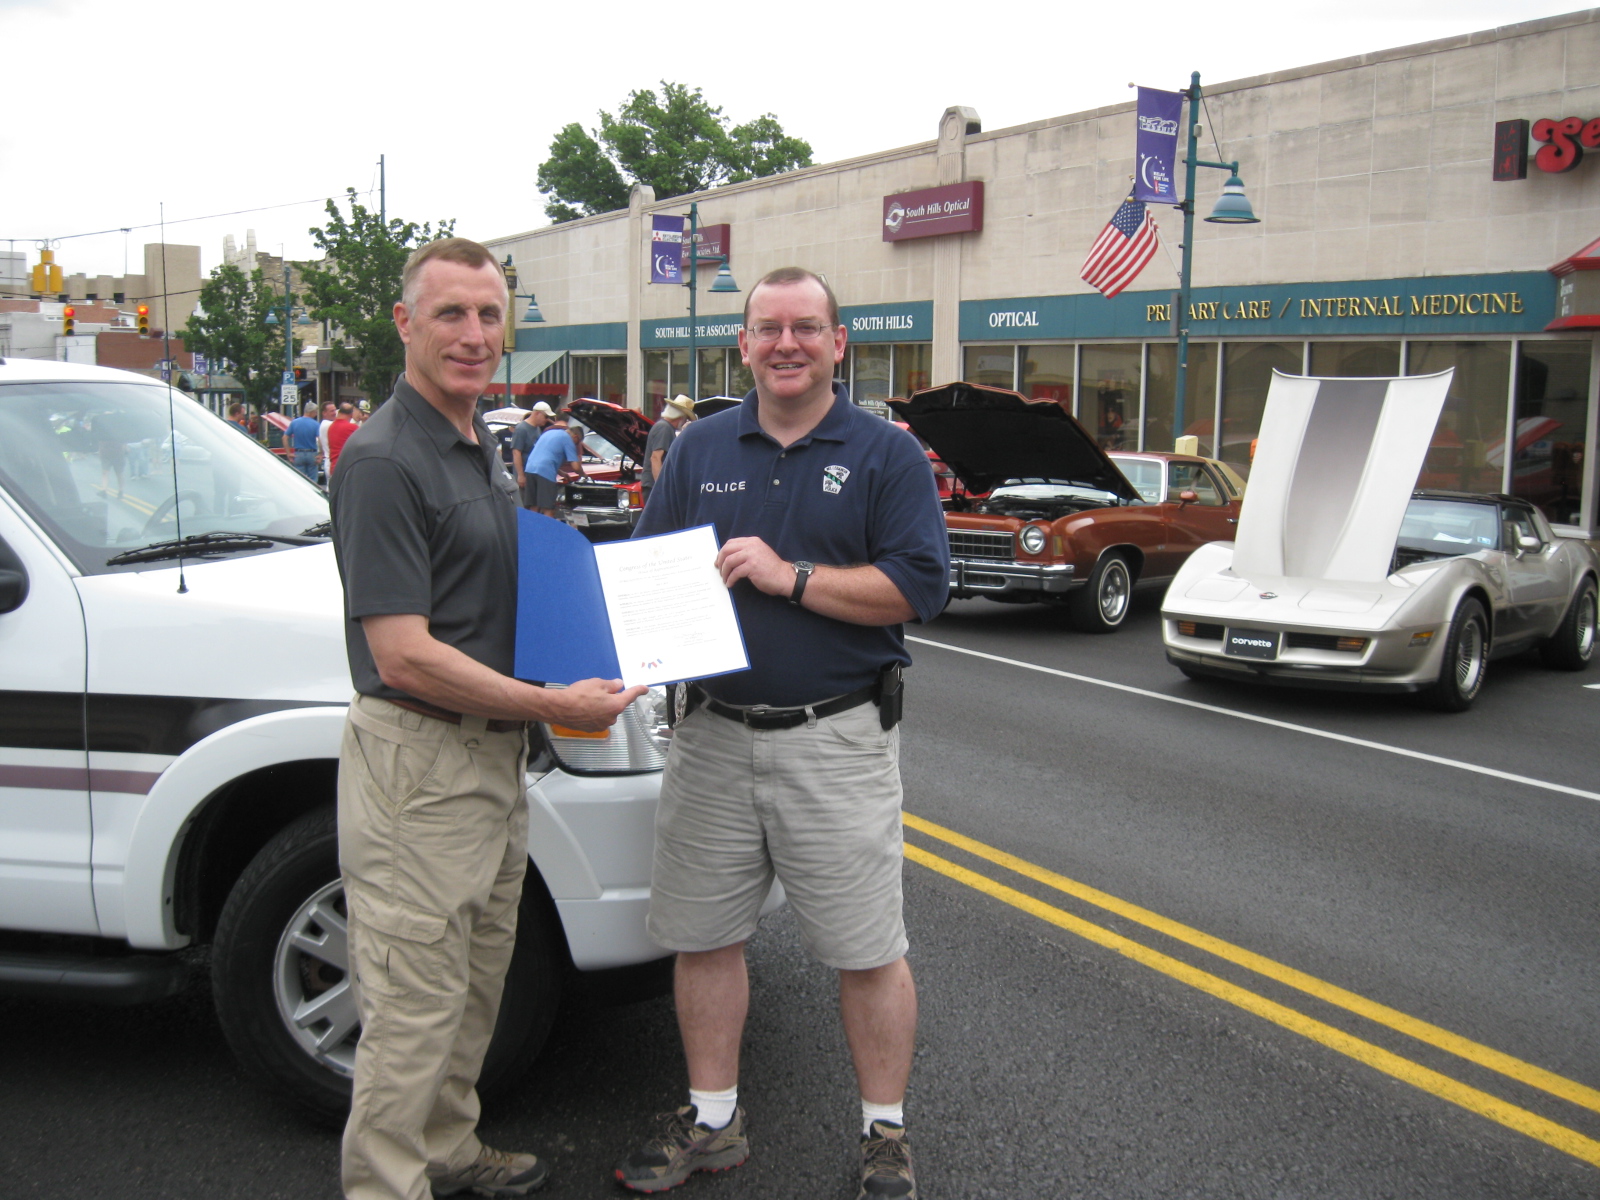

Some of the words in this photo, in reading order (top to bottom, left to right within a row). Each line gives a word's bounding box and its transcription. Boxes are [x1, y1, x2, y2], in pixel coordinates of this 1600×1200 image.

[906, 204, 925, 218] South
[927, 202, 942, 215] Hills
[943, 198, 970, 214] Optical
[1146, 301, 1220, 321] PRIARY
[1222, 300, 1271, 319] CARE
[1300, 295, 1404, 318] INTERNAL
[1410, 292, 1525, 316] MEDICINE
[852, 317, 883, 331] SOUTH
[885, 315, 913, 329] HILLS
[988, 311, 1040, 327] OPTICAL
[655, 327, 675, 338] SOUTH
[675, 326, 691, 338] HILLS
[706, 323, 744, 337] ASSOCIATE
[701, 481, 746, 493] POLICE
[618, 565, 641, 573] Congress
[1231, 636, 1272, 648] corvette
